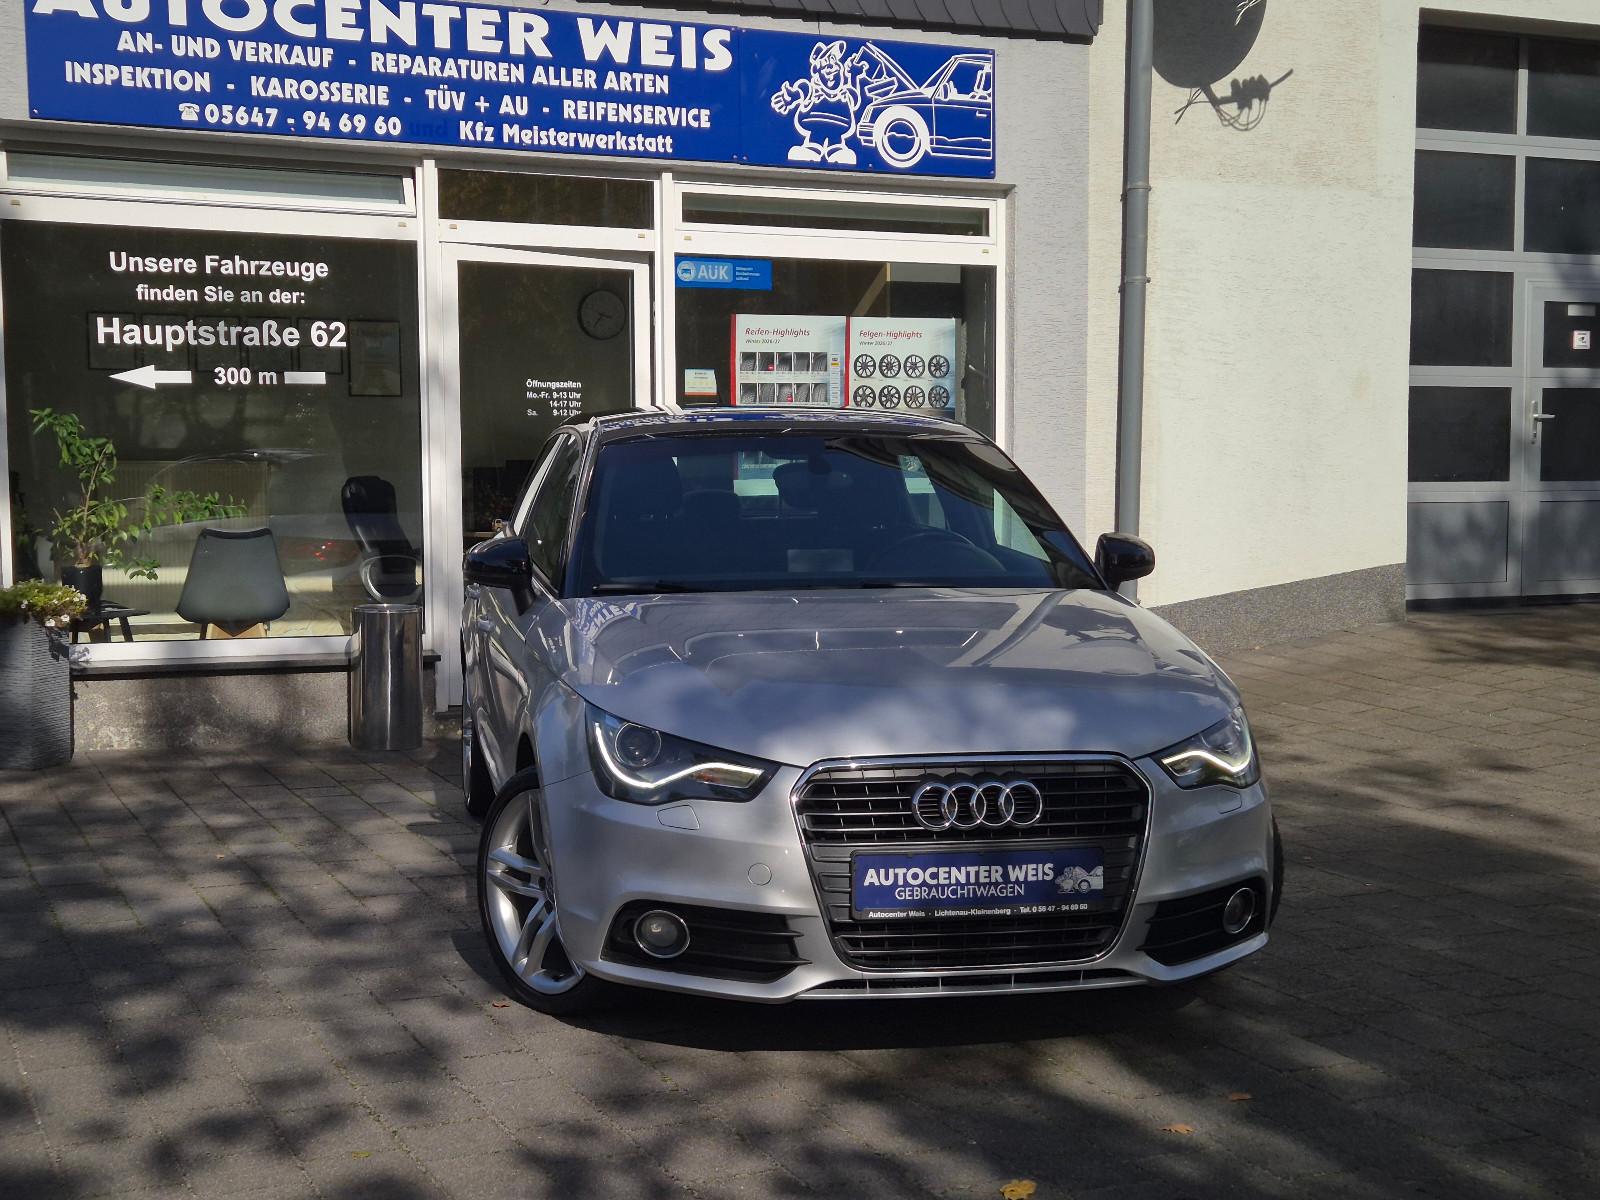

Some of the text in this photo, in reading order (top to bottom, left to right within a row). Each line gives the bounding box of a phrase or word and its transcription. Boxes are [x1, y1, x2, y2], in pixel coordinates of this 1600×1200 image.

[577, 17, 733, 71] WEIS
[116, 30, 163, 53] AN-
[171, 34, 220, 58] UND
[227, 40, 333, 68] VERKAUF
[371, 52, 524, 83] REPARATUREN
[532, 65, 598, 89] ALLER
[603, 71, 669, 95] ARTEN
[65, 61, 211, 93] INSPEKTION
[251, 76, 390, 106] KAROSSERIE
[425, 85, 466, 112] TÜV
[499, 96, 528, 116] AU
[563, 99, 711, 128] REIFENSERVICE
[204, 103, 279, 126] 05647
[303, 110, 331, 131] 94
[338, 113, 366, 134] 69
[374, 115, 402, 136] 60
[459, 120, 495, 142] Kfz
[502, 123, 673, 153] Meisterwerkstatt
[109, 251, 329, 282] Unsere Fahrzeuge
[136, 284, 306, 304] finden Sie an der:
[96, 317, 347, 352] Hauptstraße 62
[745, 327, 811, 338] Reifen-Highlights
[859, 330, 923, 340] Felgen-Highlights
[213, 367, 278, 385] 300 m
[526, 379, 581, 389] Öffnungszeiten
[526, 391, 582, 399] Mo.-Fr. 9-13 Uhr
[549, 400, 582, 408] 14-17 Uhr
[552, 408, 567, 416] 9-12
[568, 409, 582, 417] Uhr
[863, 863, 1054, 887] AUTOCENTER WEIS
[895, 884, 1025, 900] GEBRAUCHTWAGEN
[934, 908, 1012, 916] Lichtenau-Kleinenberg
[1032, 905, 1038, 914] 0
